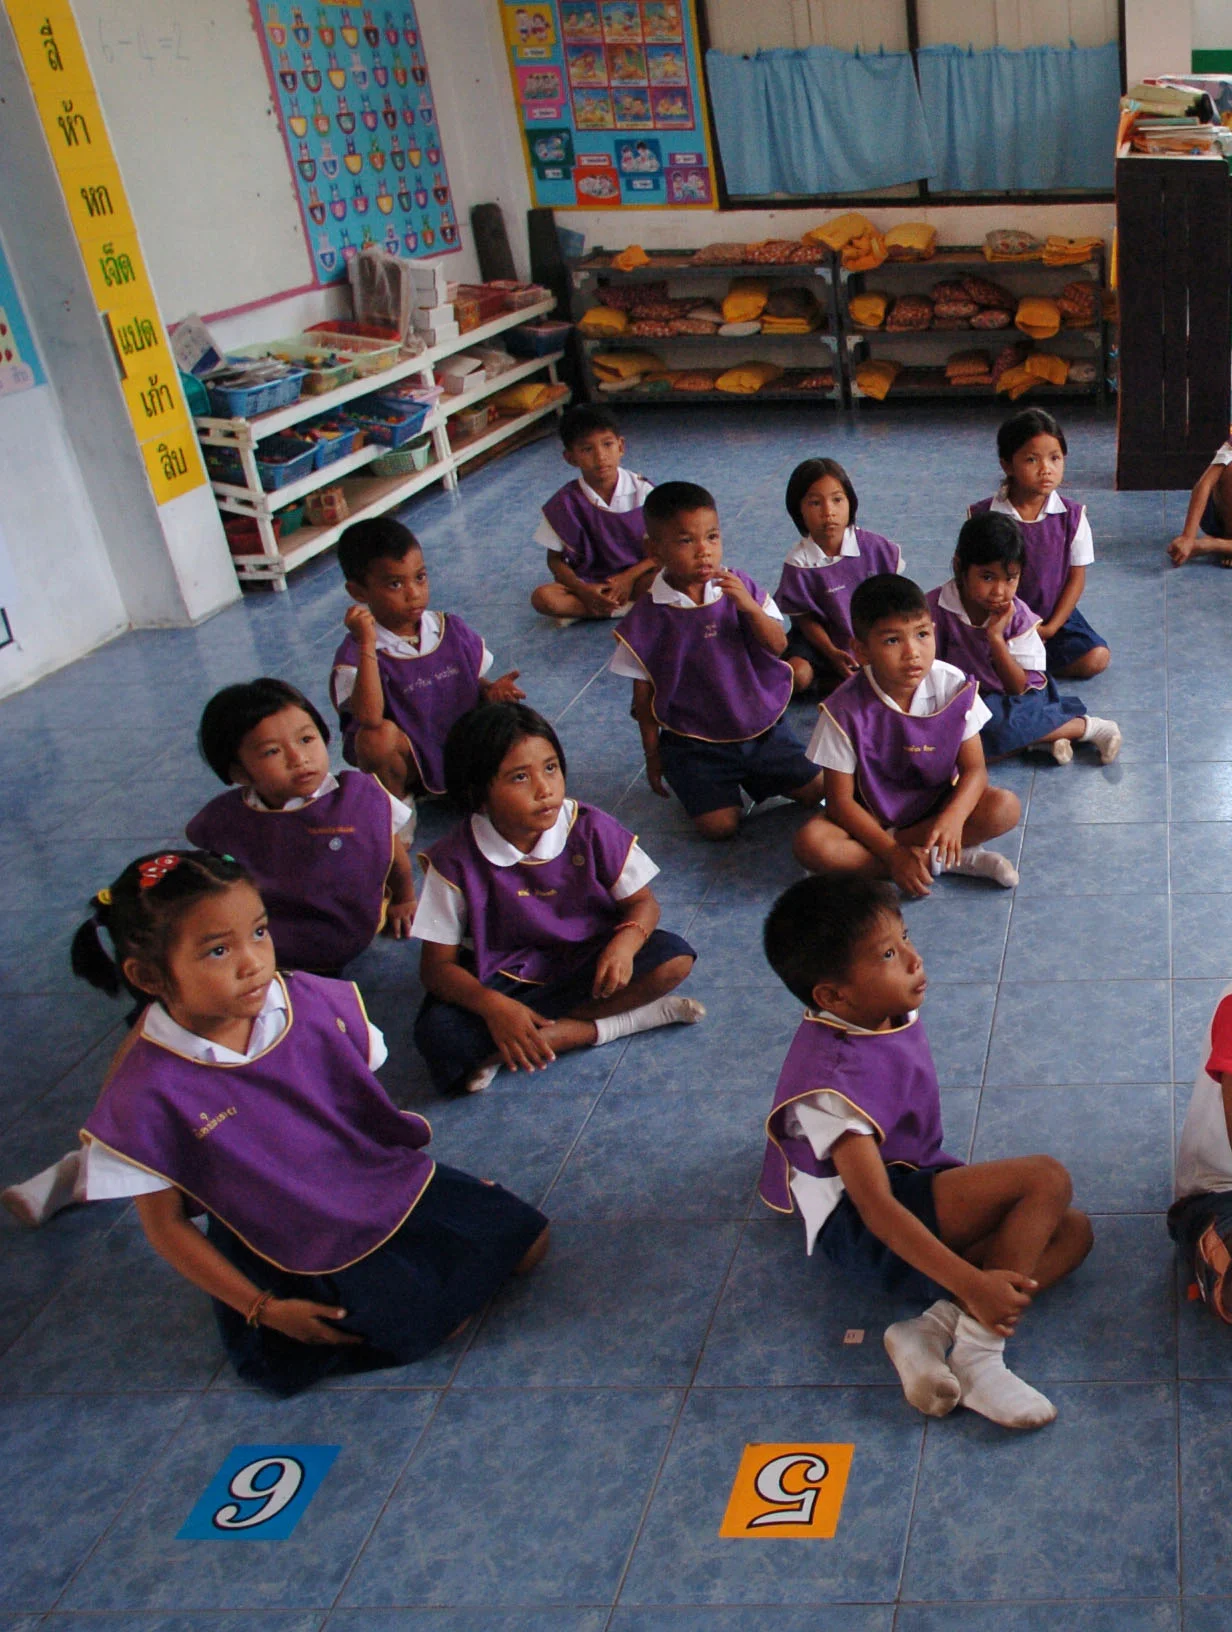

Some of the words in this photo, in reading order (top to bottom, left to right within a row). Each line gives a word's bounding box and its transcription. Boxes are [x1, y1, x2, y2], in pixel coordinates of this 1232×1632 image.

[57, 99, 91, 147] ห้า
[80, 185, 114, 217] หก
[99, 242, 136, 287] เจ็ด
[117, 317, 158, 355] แปด
[140, 374, 174, 418] เก้า
[158, 443, 187, 480] สิบ
[746, 1452, 829, 1529] 5
